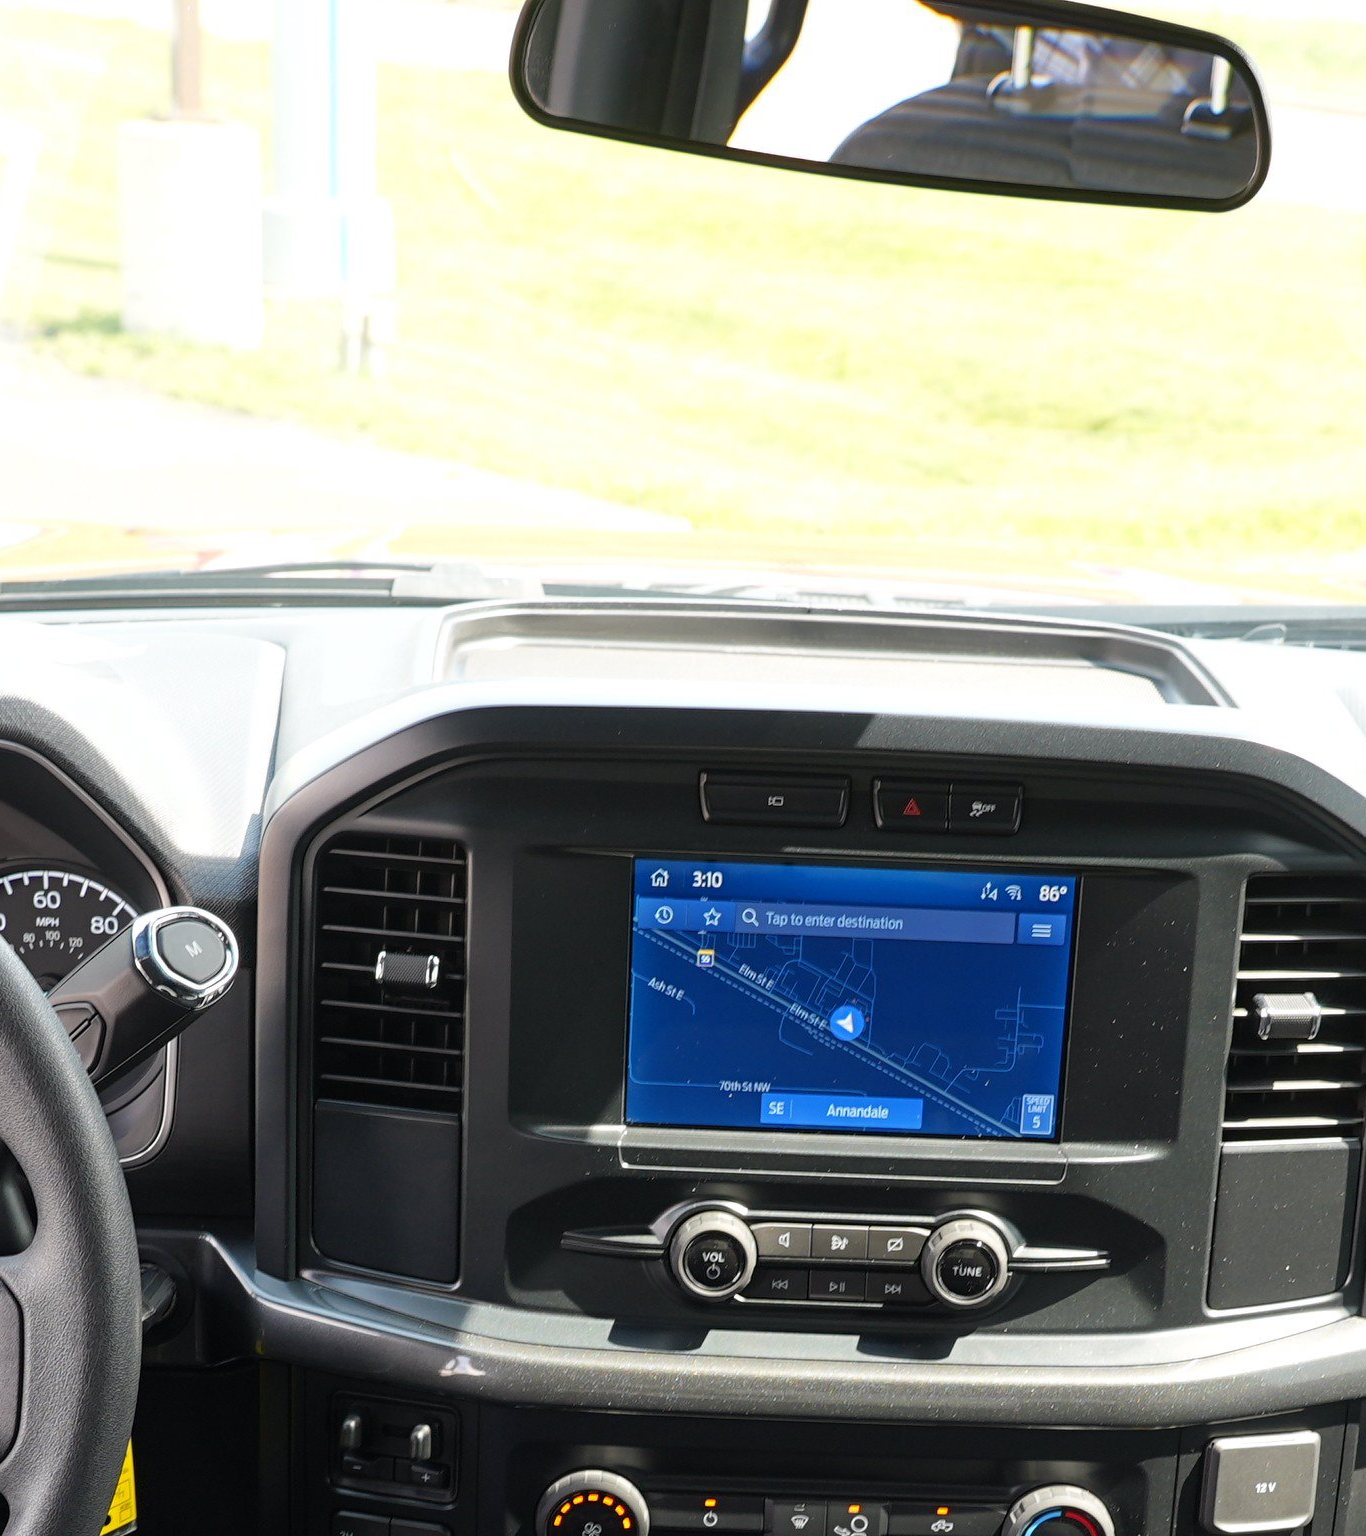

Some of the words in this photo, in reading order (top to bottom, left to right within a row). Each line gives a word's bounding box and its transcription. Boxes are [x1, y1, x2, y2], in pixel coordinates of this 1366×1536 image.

[982, 803, 996, 813] OFF
[692, 870, 723, 888] 3:10
[33, 890, 61, 909] 60
[1039, 885, 1068, 902] 86°
[35, 916, 60, 928] MPH
[90, 916, 119, 935] 80
[766, 911, 788, 927] Tap
[791, 912, 803, 926] to
[805, 913, 835, 928] enter
[837, 913, 904, 931] destination
[23, 932, 35, 943] 80
[45, 930, 61, 942] 100
[69, 937, 83, 948] 120
[185, 942, 203, 957] M
[738, 963, 757, 981] Elm
[755, 973, 766, 987] St
[766, 980, 775, 990] E
[647, 977, 666, 993] Ash
[665, 984, 676, 998] St
[676, 990, 685, 1001] E
[789, 1002, 809, 1020] Elm
[807, 1013, 819, 1026] St
[819, 1019, 828, 1031] E
[719, 1080, 741, 1092] 70th
[741, 1081, 753, 1092] St
[753, 1082, 771, 1093] NW
[1026, 1096, 1051, 1105] SPEED
[768, 1101, 785, 1115] SE
[826, 1103, 889, 1119] Annandale
[1028, 1104, 1047, 1113] LIMIT
[1032, 1115, 1041, 1129] 5
[702, 1251, 725, 1263] VOL
[952, 1265, 983, 1278] TUNE
